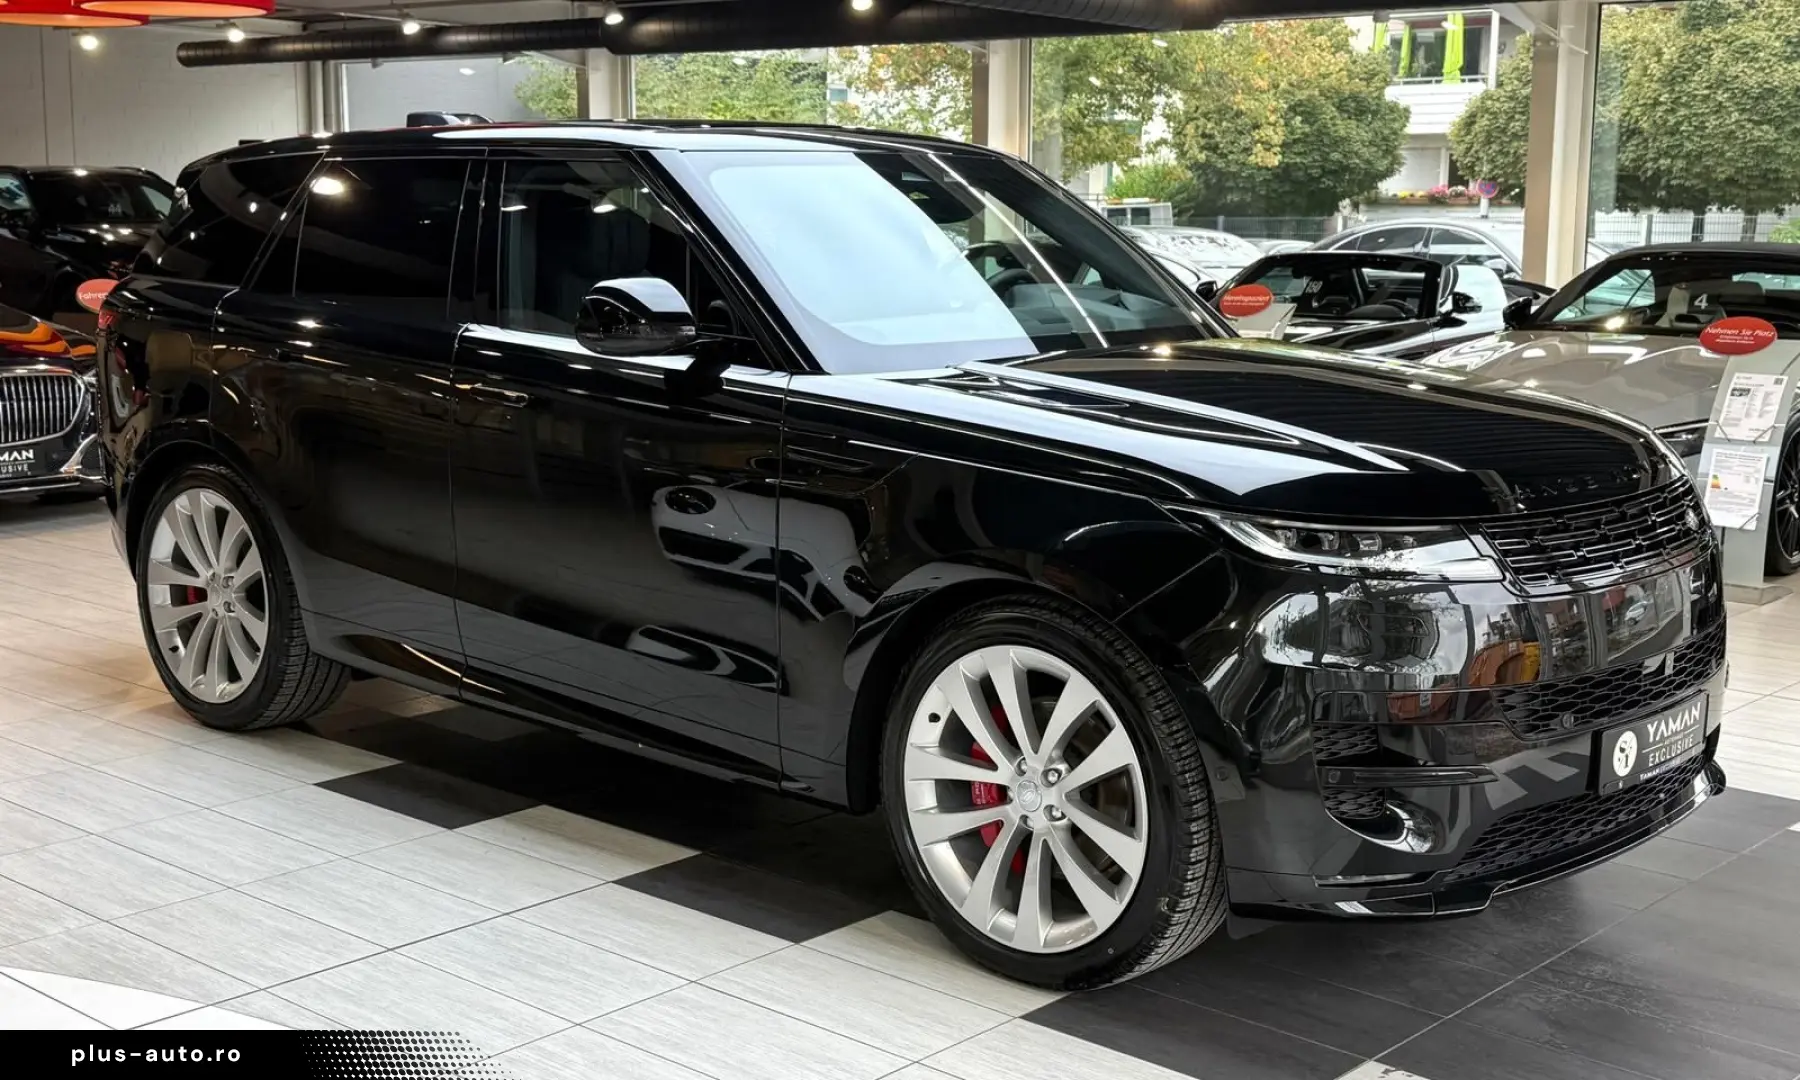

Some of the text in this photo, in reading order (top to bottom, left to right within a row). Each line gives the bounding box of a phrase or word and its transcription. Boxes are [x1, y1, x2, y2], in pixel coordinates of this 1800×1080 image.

[1693, 293, 1709, 310] 4
[1647, 702, 1701, 743] YAMAN
[1648, 734, 1693, 767] EXCLUSIVE
